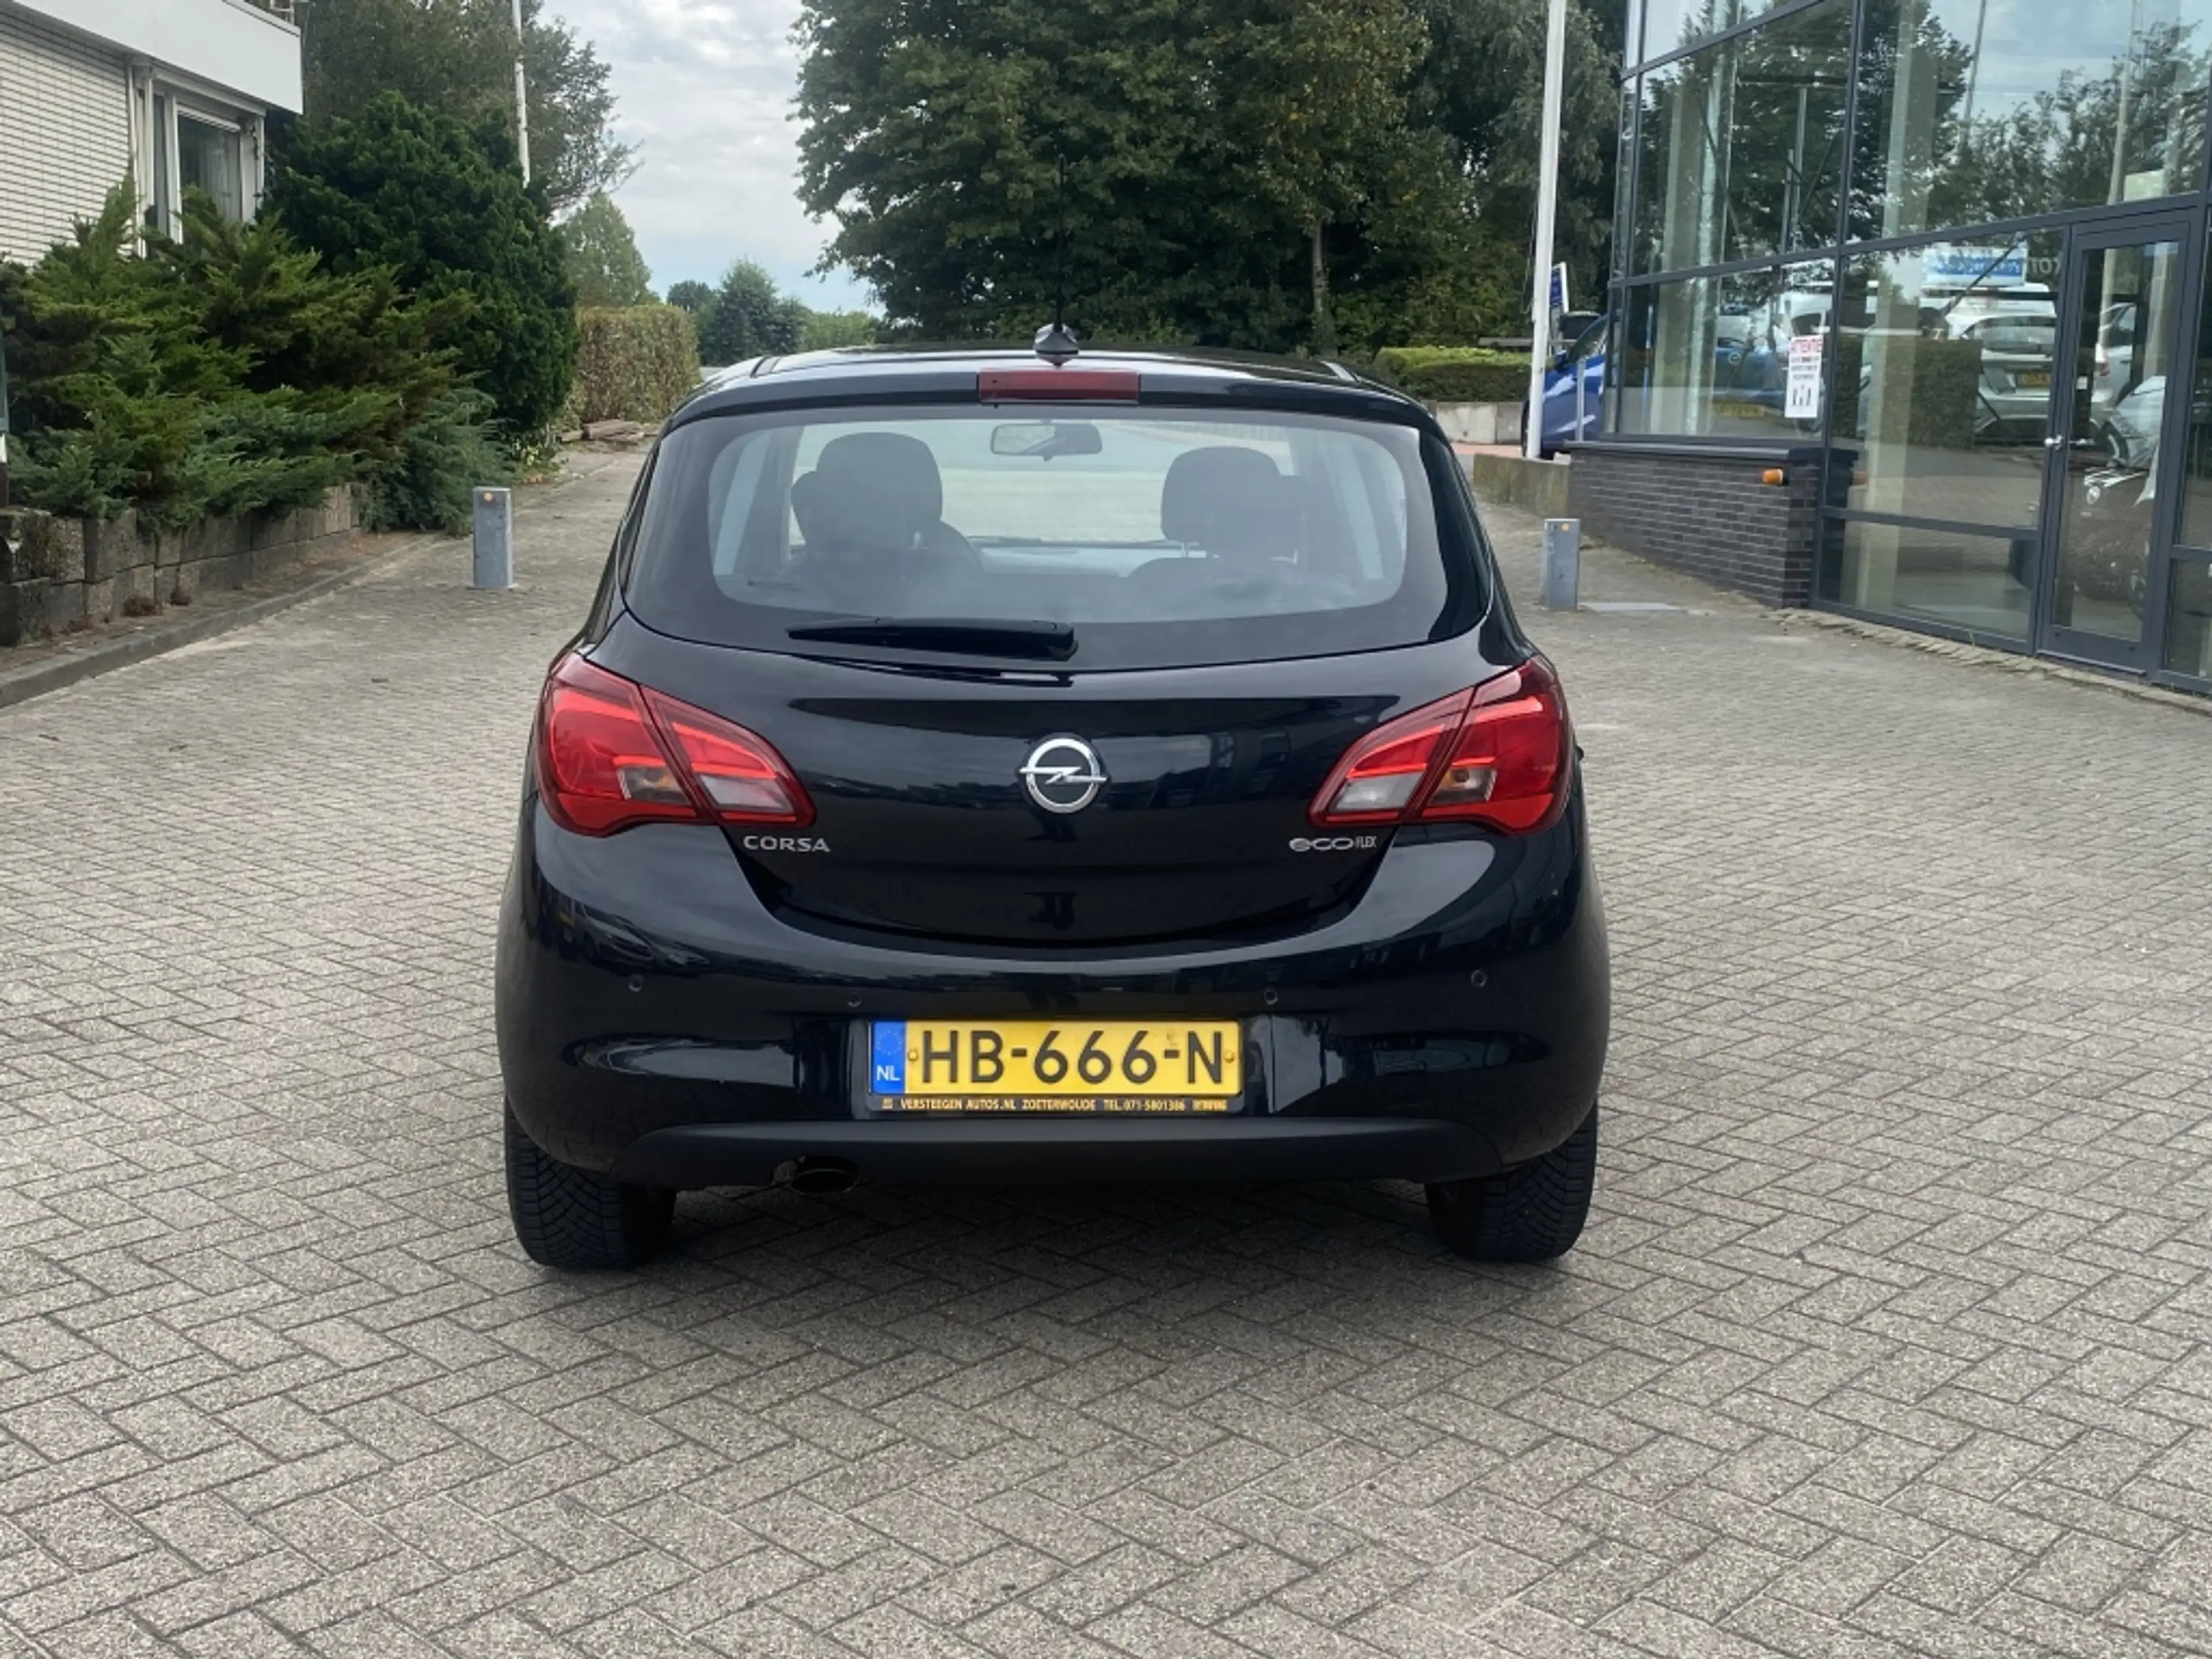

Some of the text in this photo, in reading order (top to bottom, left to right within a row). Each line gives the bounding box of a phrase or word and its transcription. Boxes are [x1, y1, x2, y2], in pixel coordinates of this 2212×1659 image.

[743, 836, 831, 852] CORSA
[922, 1031, 1222, 1085] HB-666-N
[877, 1065, 901, 1081] NL
